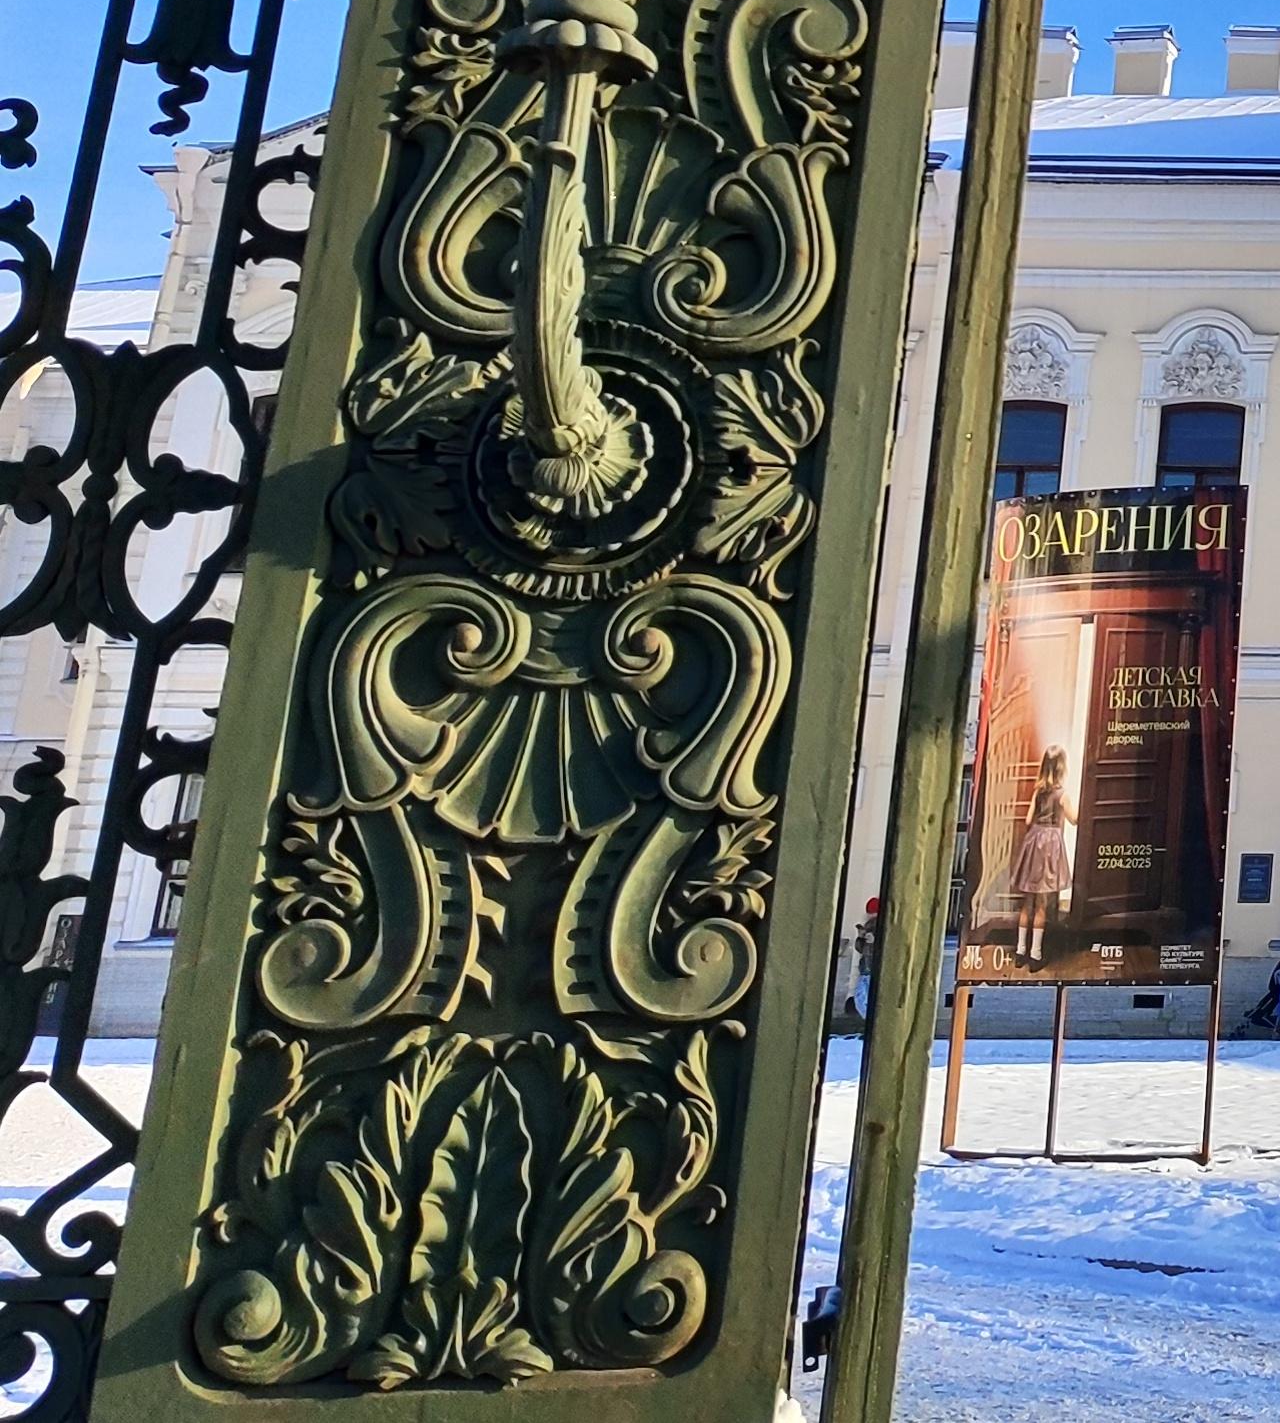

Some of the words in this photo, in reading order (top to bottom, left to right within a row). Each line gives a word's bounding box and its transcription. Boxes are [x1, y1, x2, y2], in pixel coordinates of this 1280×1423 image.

[998, 504, 1233, 562] ОЗАРЕНИЯ
[1108, 666, 1202, 690] ДЕТСКАЯ
[1108, 687, 1220, 709] ВЫСТАВКА
[1107, 720, 1191, 733] Шереметевский
[1105, 734, 1144, 745] дворец
[1098, 844, 1152, 856] 03.01.2025
[1097, 858, 1152, 869] 27.04.2025
[993, 945, 1012, 970] 0+
[1101, 945, 1123, 958] ВТБ
